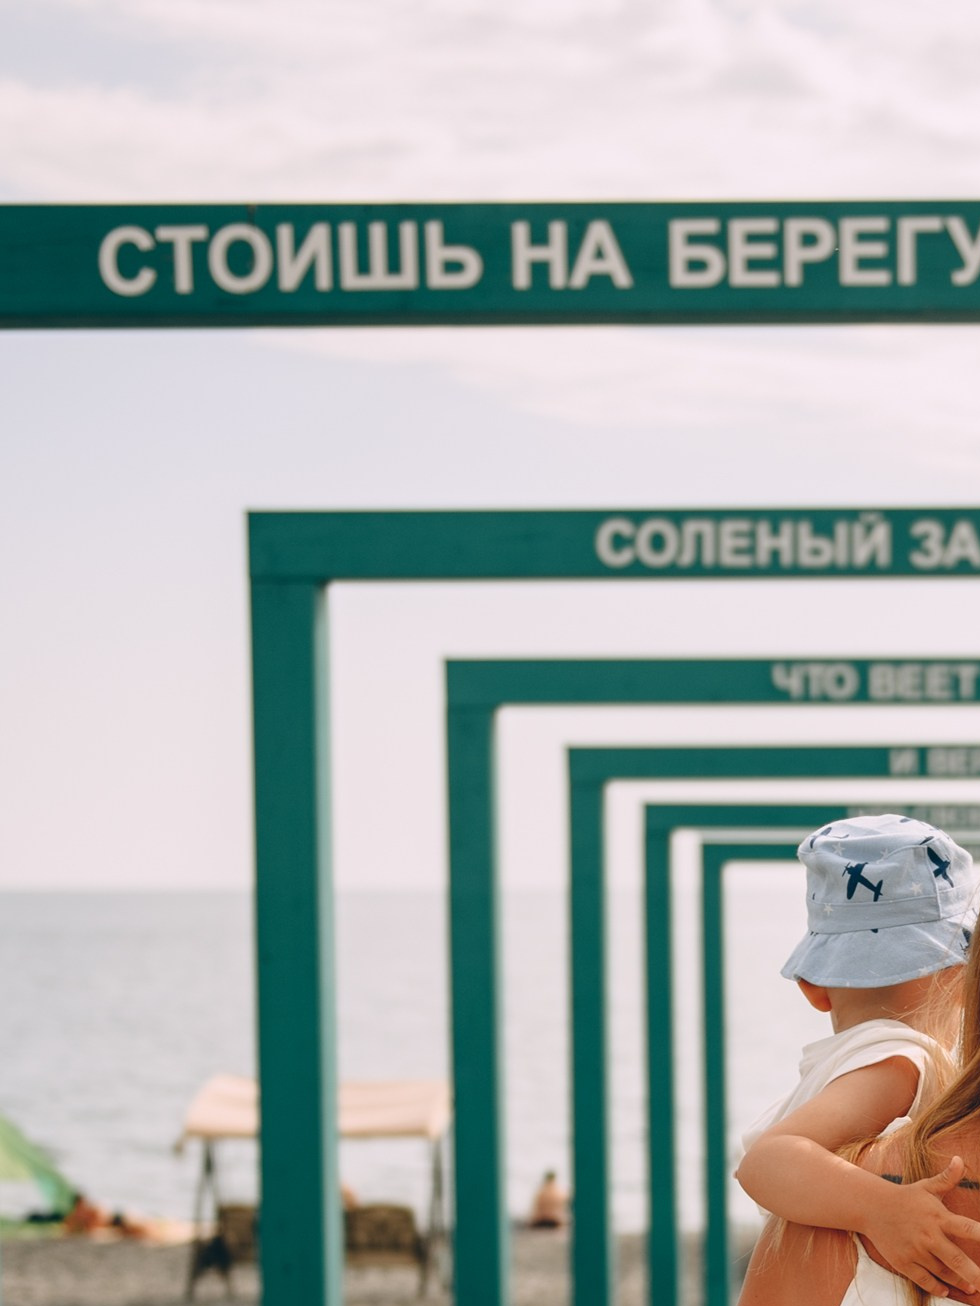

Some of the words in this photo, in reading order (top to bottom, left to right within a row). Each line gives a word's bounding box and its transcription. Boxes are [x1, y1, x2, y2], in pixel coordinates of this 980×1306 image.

[98, 221, 484, 296] СТОИШЬ
[511, 220, 633, 290] НА
[595, 513, 891, 568] СОЛЕНЫЙ
[771, 664, 860, 699] ЧТО
[868, 664, 980, 699] ВЕЕТ
